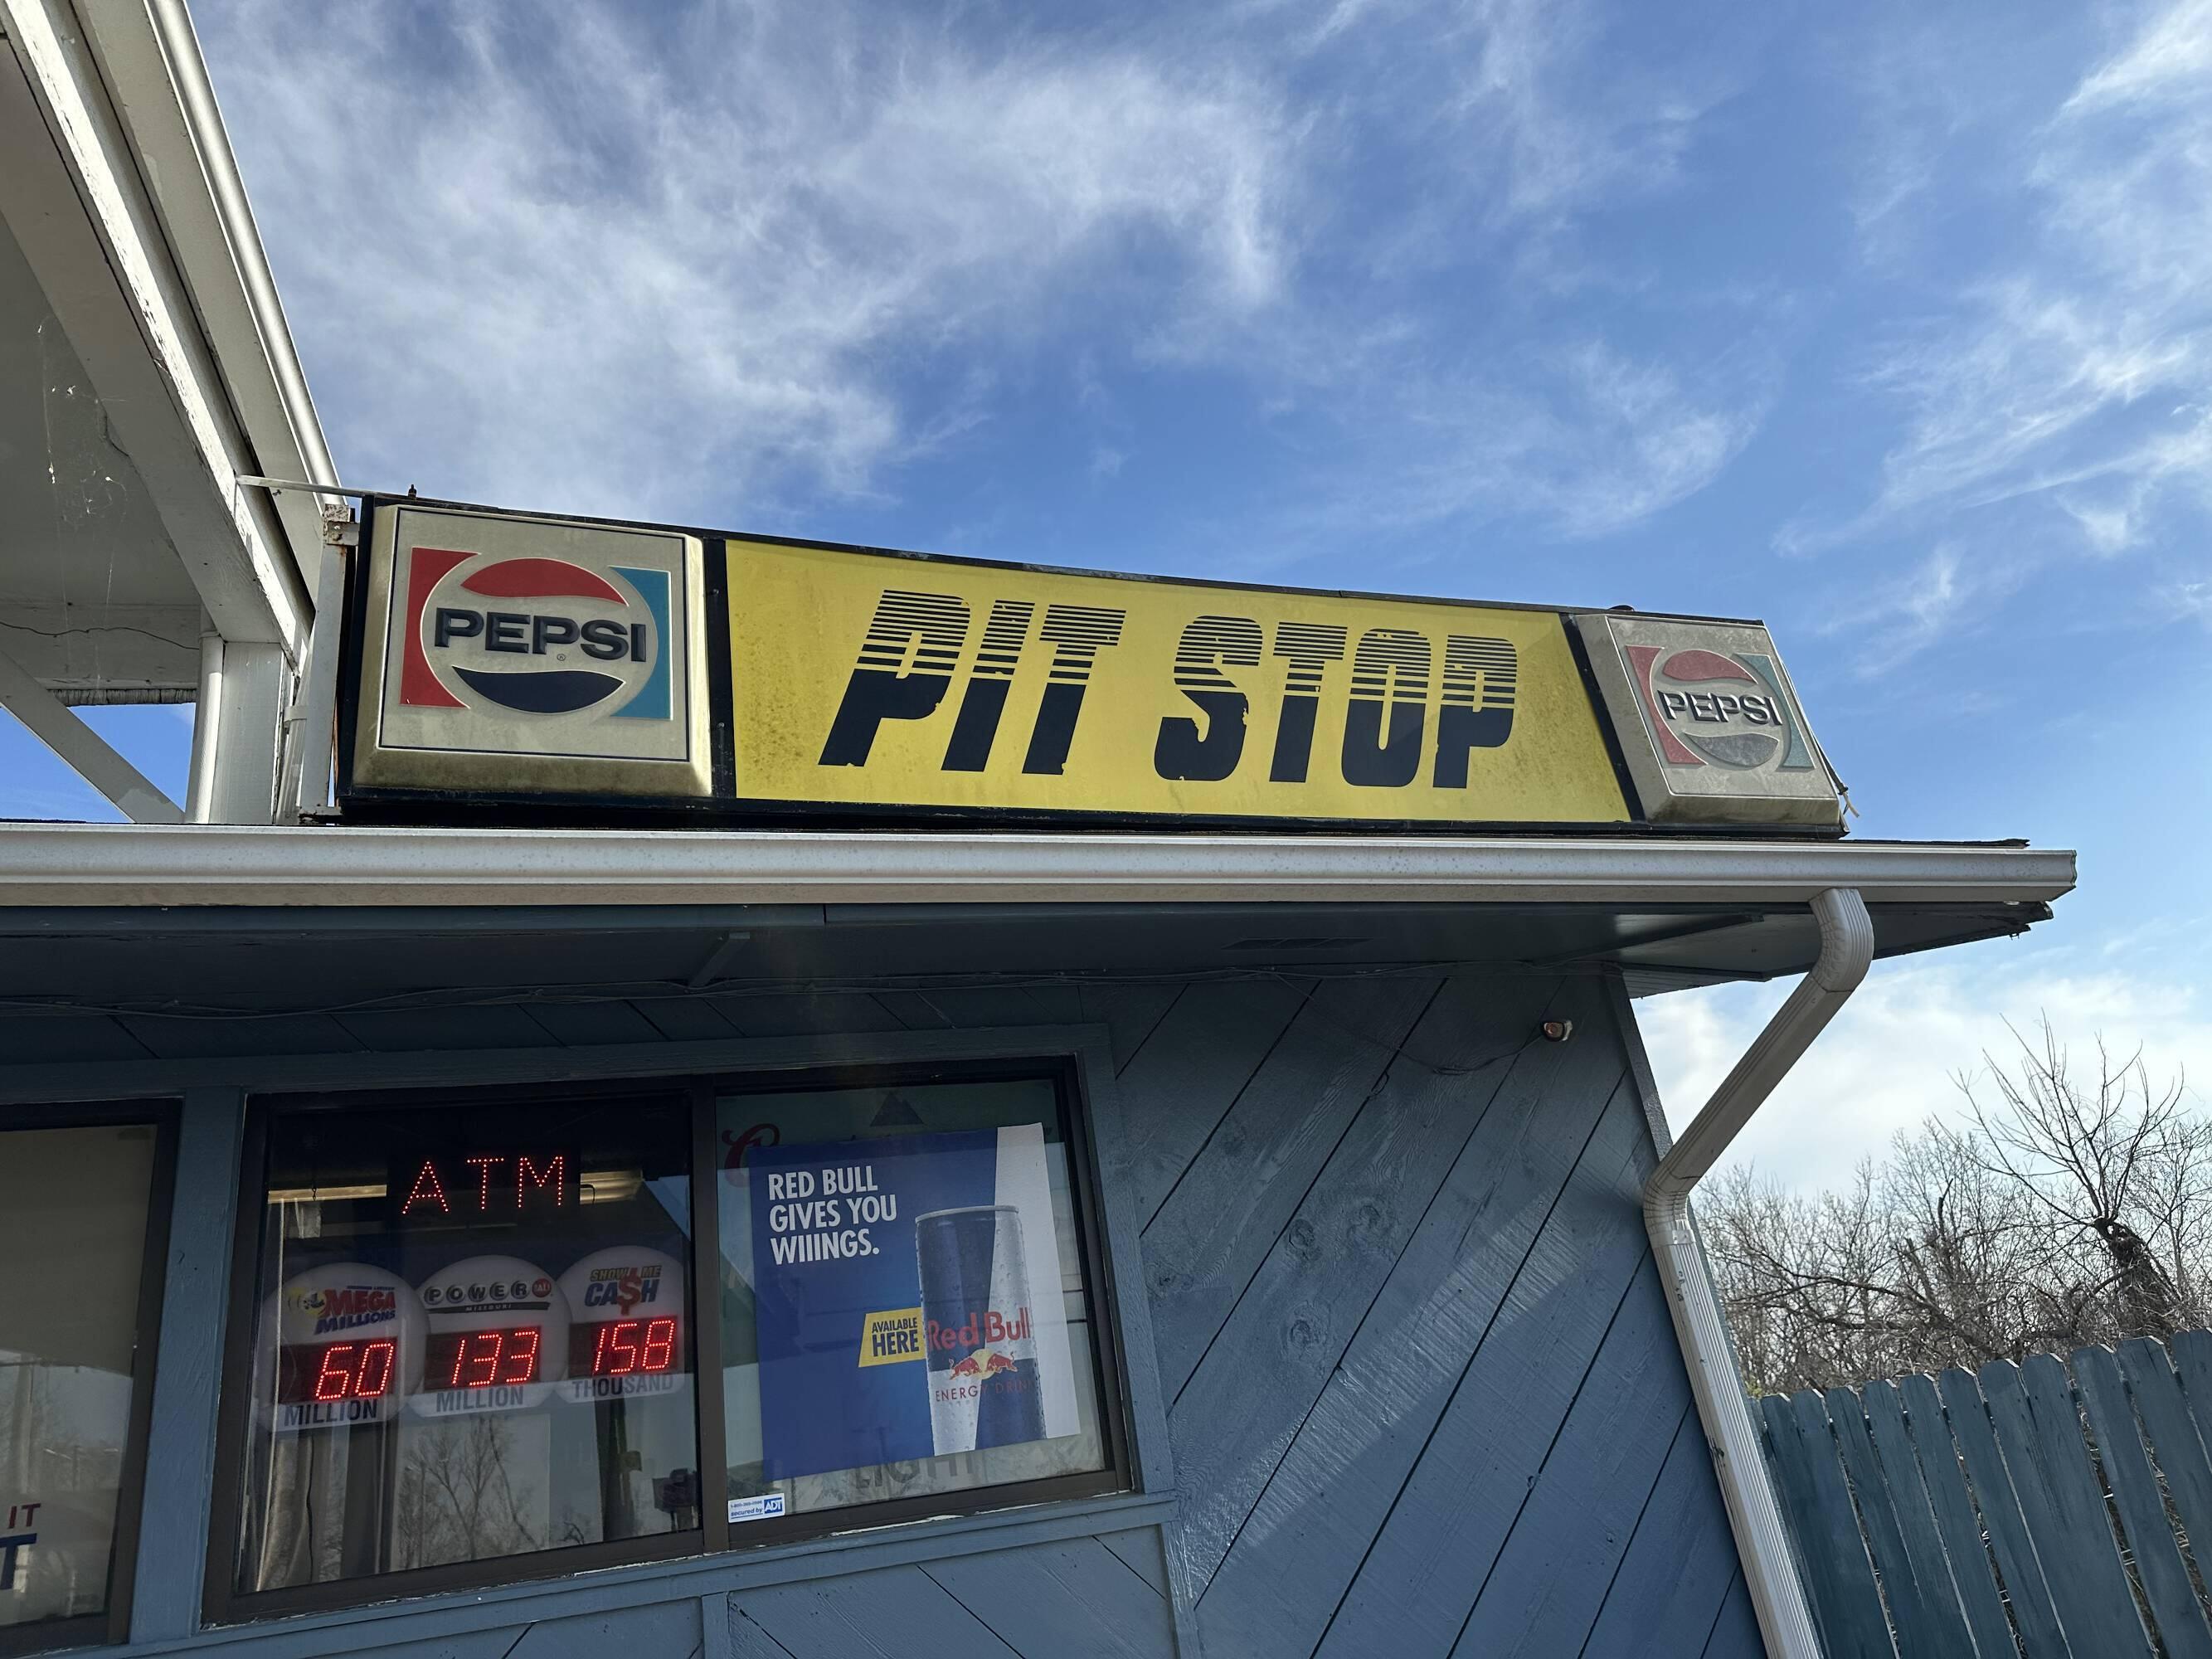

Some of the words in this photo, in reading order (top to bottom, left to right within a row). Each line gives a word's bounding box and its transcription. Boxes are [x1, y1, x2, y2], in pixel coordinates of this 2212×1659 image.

[434, 607, 647, 662] PEPSI
[818, 589, 1127, 776] PIT
[1154, 615, 1519, 789] STOP
[1657, 689, 1783, 726] PEPSI
[402, 1155, 564, 1214] ATM
[768, 1171, 815, 1200] RED
[822, 1165, 878, 1195] BULL
[770, 1199, 841, 1233] GIVES
[846, 1194, 897, 1224] YOU
[770, 1228, 880, 1265] WIIINGS.
[590, 1267, 629, 1282] SHOW
[641, 1265, 663, 1278] ME
[318, 1289, 396, 1317] MEGA
[314, 1310, 396, 1335] MILLIONS
[872, 1317, 917, 1333] AVAILABLE
[927, 1312, 980, 1351] Red
[984, 1307, 1031, 1343] Bull
[450, 1330, 540, 1386] 133
[592, 1319, 676, 1374] 158
[873, 1330, 920, 1357] HERE
[314, 1342, 395, 1401] 60
[572, 1374, 673, 1399] THOUSAND
[436, 1385, 524, 1413] MILLION
[936, 1384, 987, 1402] ENERGY
[284, 1399, 377, 1427] MILLION
[7, 1502, 41, 1529] IT
[765, 1500, 782, 1511] ADT
